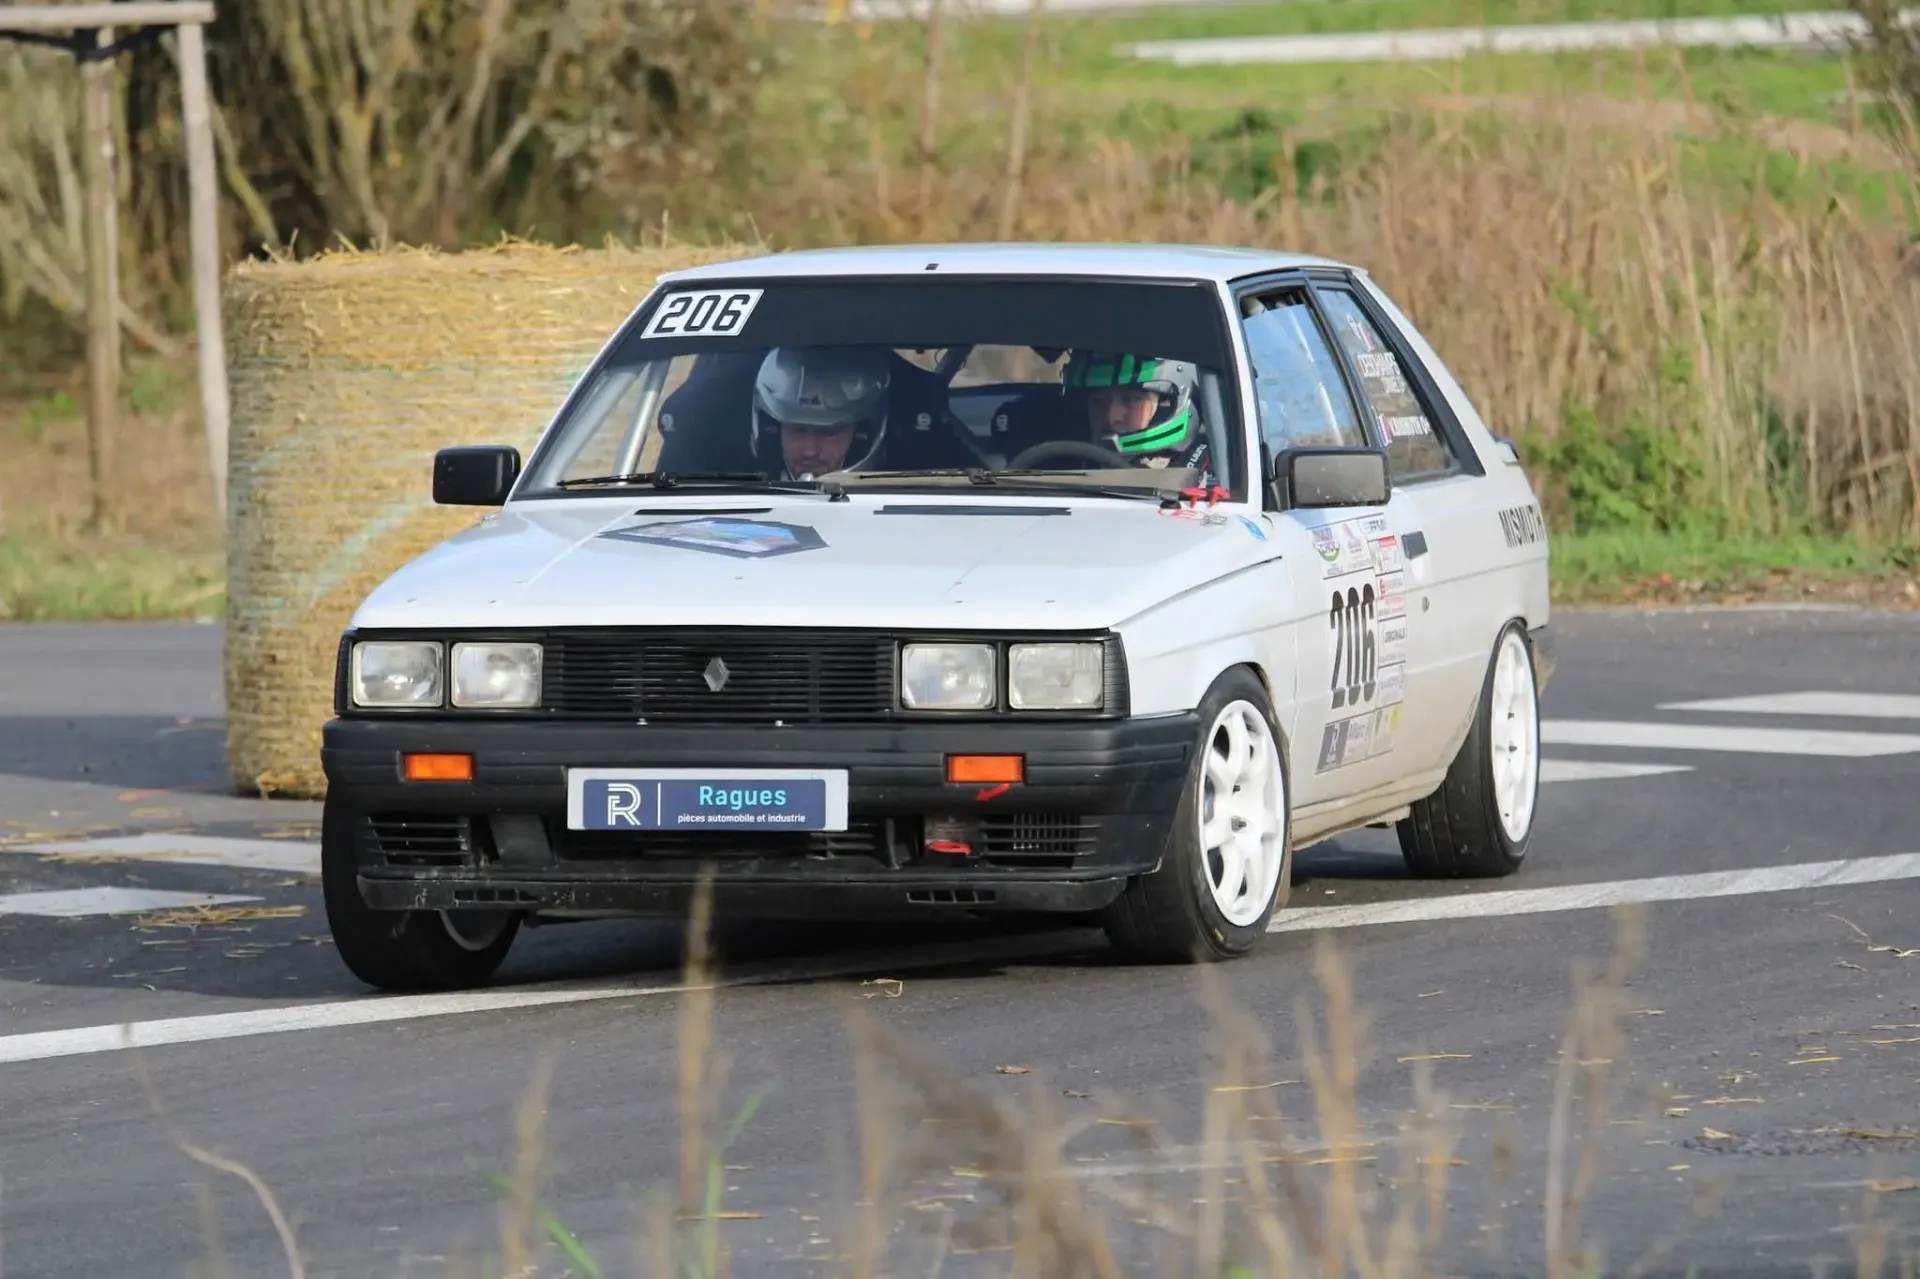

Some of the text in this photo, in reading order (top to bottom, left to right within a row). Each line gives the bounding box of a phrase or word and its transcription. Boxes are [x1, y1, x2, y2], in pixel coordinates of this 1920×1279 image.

[653, 294, 751, 334] 206
[1330, 583, 1376, 710] 206
[699, 785, 787, 811] Ragues
[677, 813, 806, 824] pièces automobile et industrie
